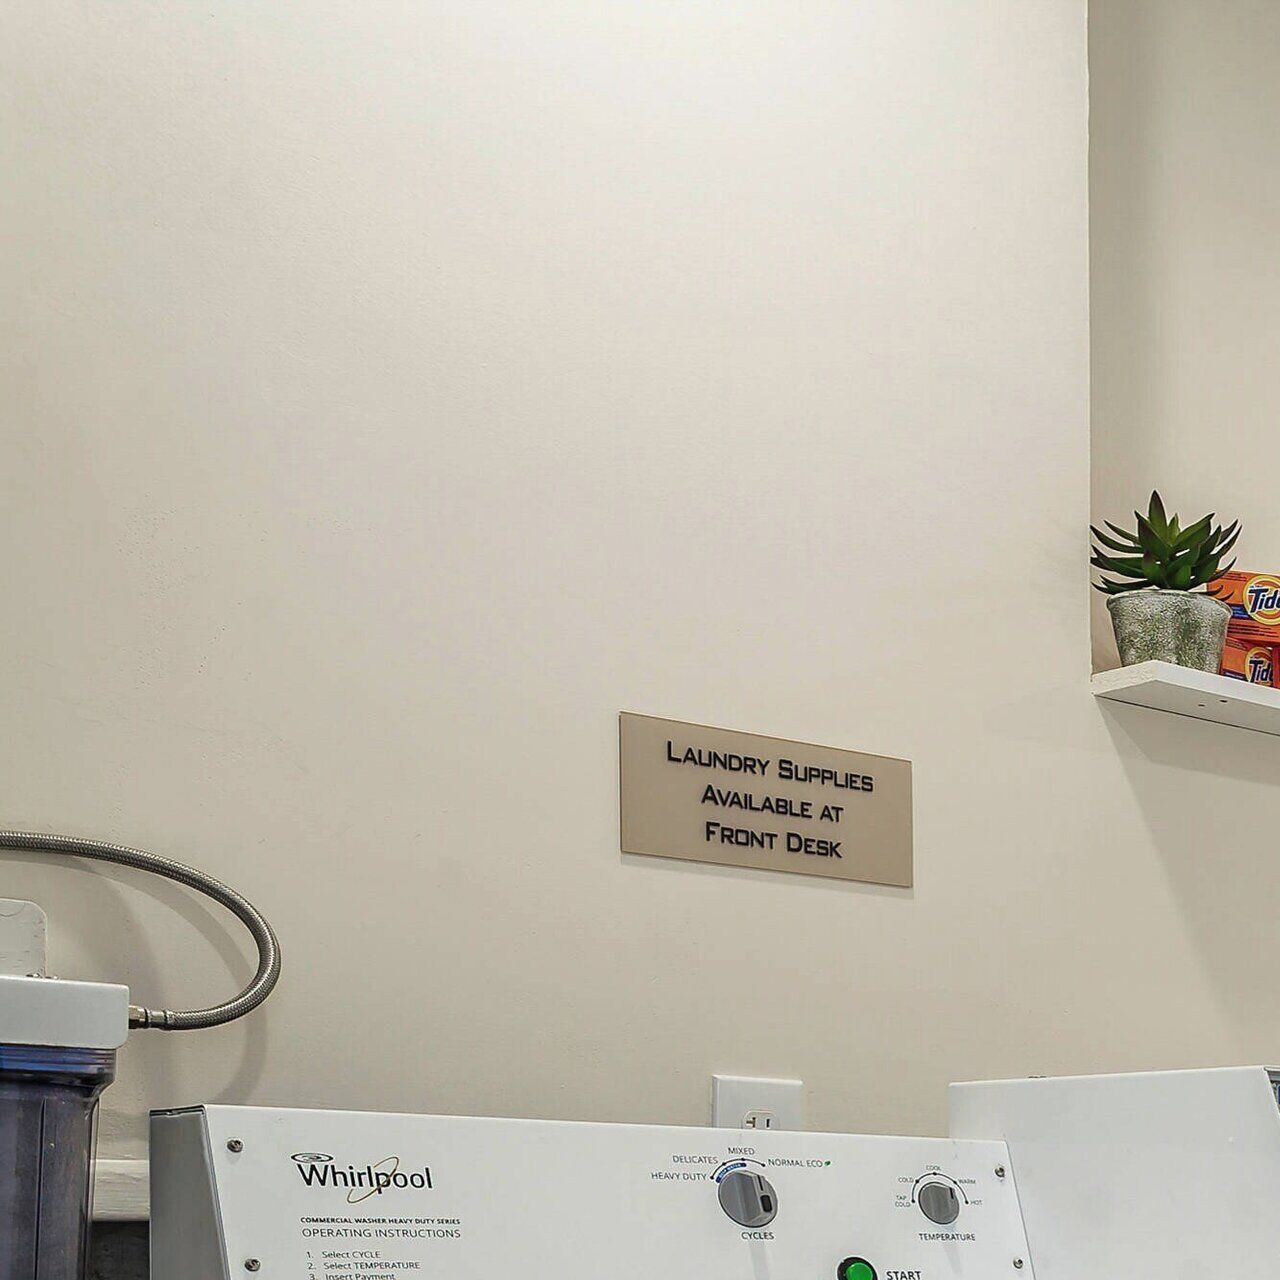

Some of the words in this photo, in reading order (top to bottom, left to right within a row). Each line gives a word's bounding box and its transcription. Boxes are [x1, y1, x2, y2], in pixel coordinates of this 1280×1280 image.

[1249, 660, 1273, 683] Tid
[667, 740, 770, 775] LAUNDRY
[778, 759, 874, 792] SUPPLIES
[702, 784, 813, 818] AVAILABLE
[820, 805, 844, 822] AT
[706, 821, 777, 850] FRONT
[787, 833, 843, 859] DESK
[728, 1147, 755, 1155] MIXED
[672, 1156, 718, 1164] DELICATES
[768, 1159, 805, 1167] NORMAL
[297, 1163, 433, 1194] Whirlpool
[302, 1228, 372, 1238] OPERATING
[375, 1229, 461, 1238] INSTRUCTIONS
[741, 1232, 774, 1240] CYCLES
[919, 1233, 976, 1241] TEMPERATURE
[322, 1251, 350, 1259] Select
[352, 1251, 381, 1259] CYCLE
[307, 1262, 316, 1270] 2.
[324, 1262, 352, 1270] Select
[354, 1262, 420, 1270] TEMPERATURE
[309, 1273, 318, 1280] 3.
[325, 1273, 353, 1280] Insert
[886, 1270, 921, 1280] START
